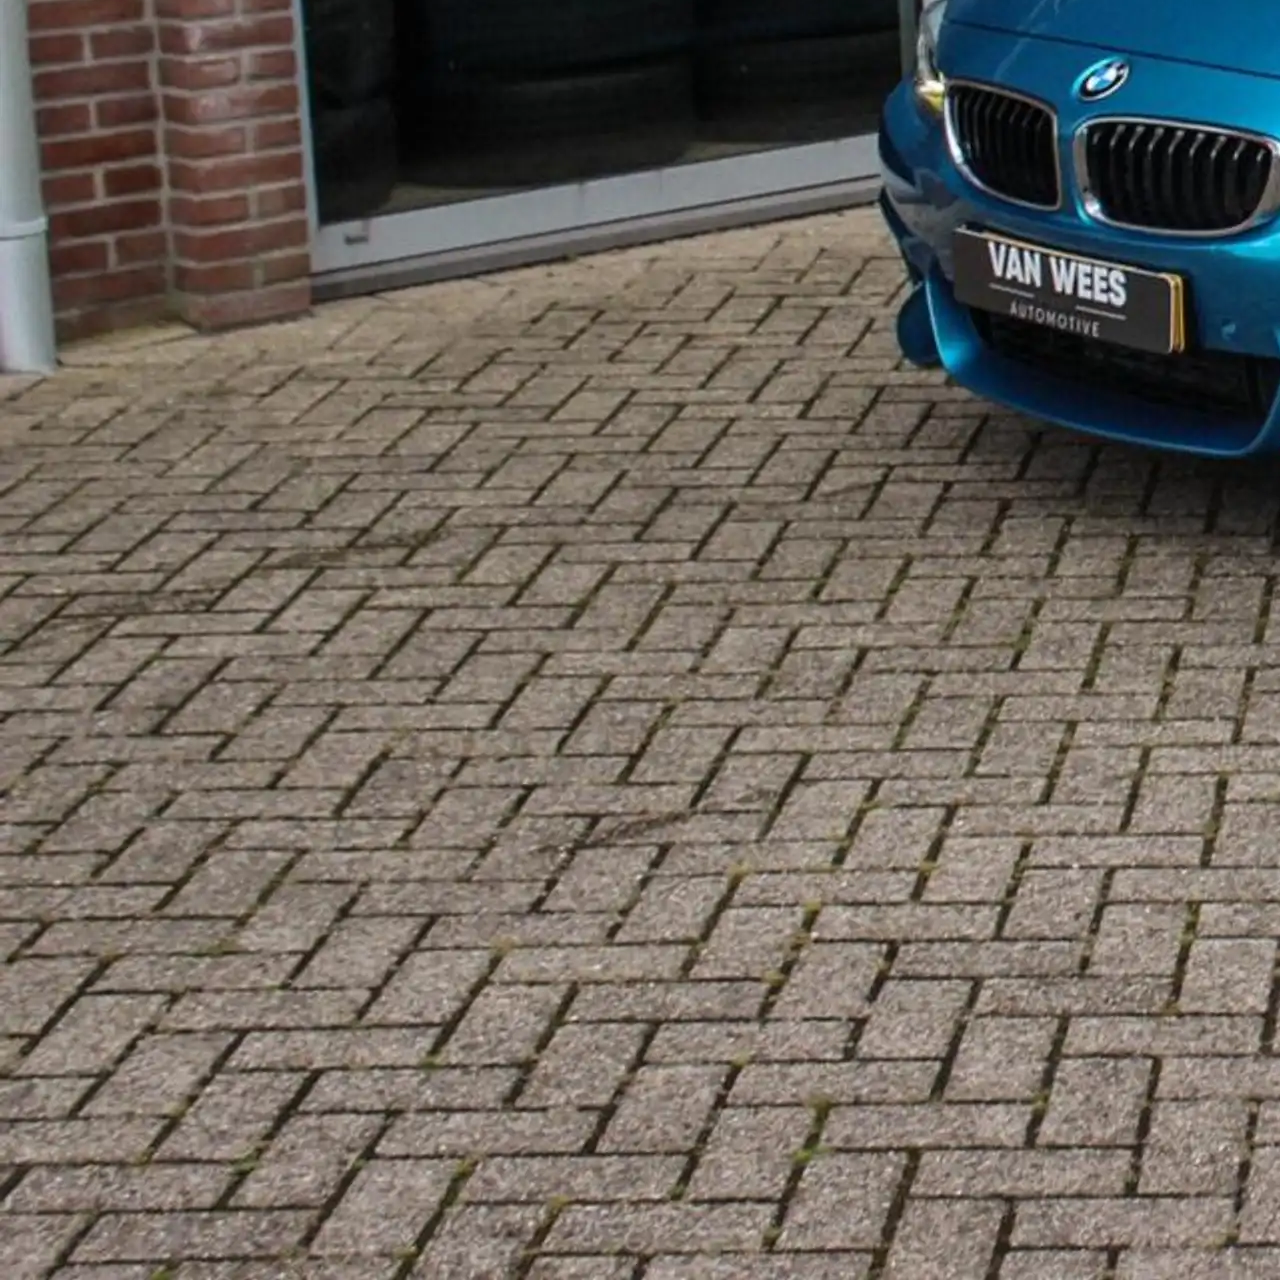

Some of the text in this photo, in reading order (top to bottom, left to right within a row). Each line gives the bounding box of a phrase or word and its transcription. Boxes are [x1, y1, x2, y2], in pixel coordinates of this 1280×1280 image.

[988, 240, 1128, 307] VAN WEES
[1010, 300, 1100, 338] AUTOMOTIVE
